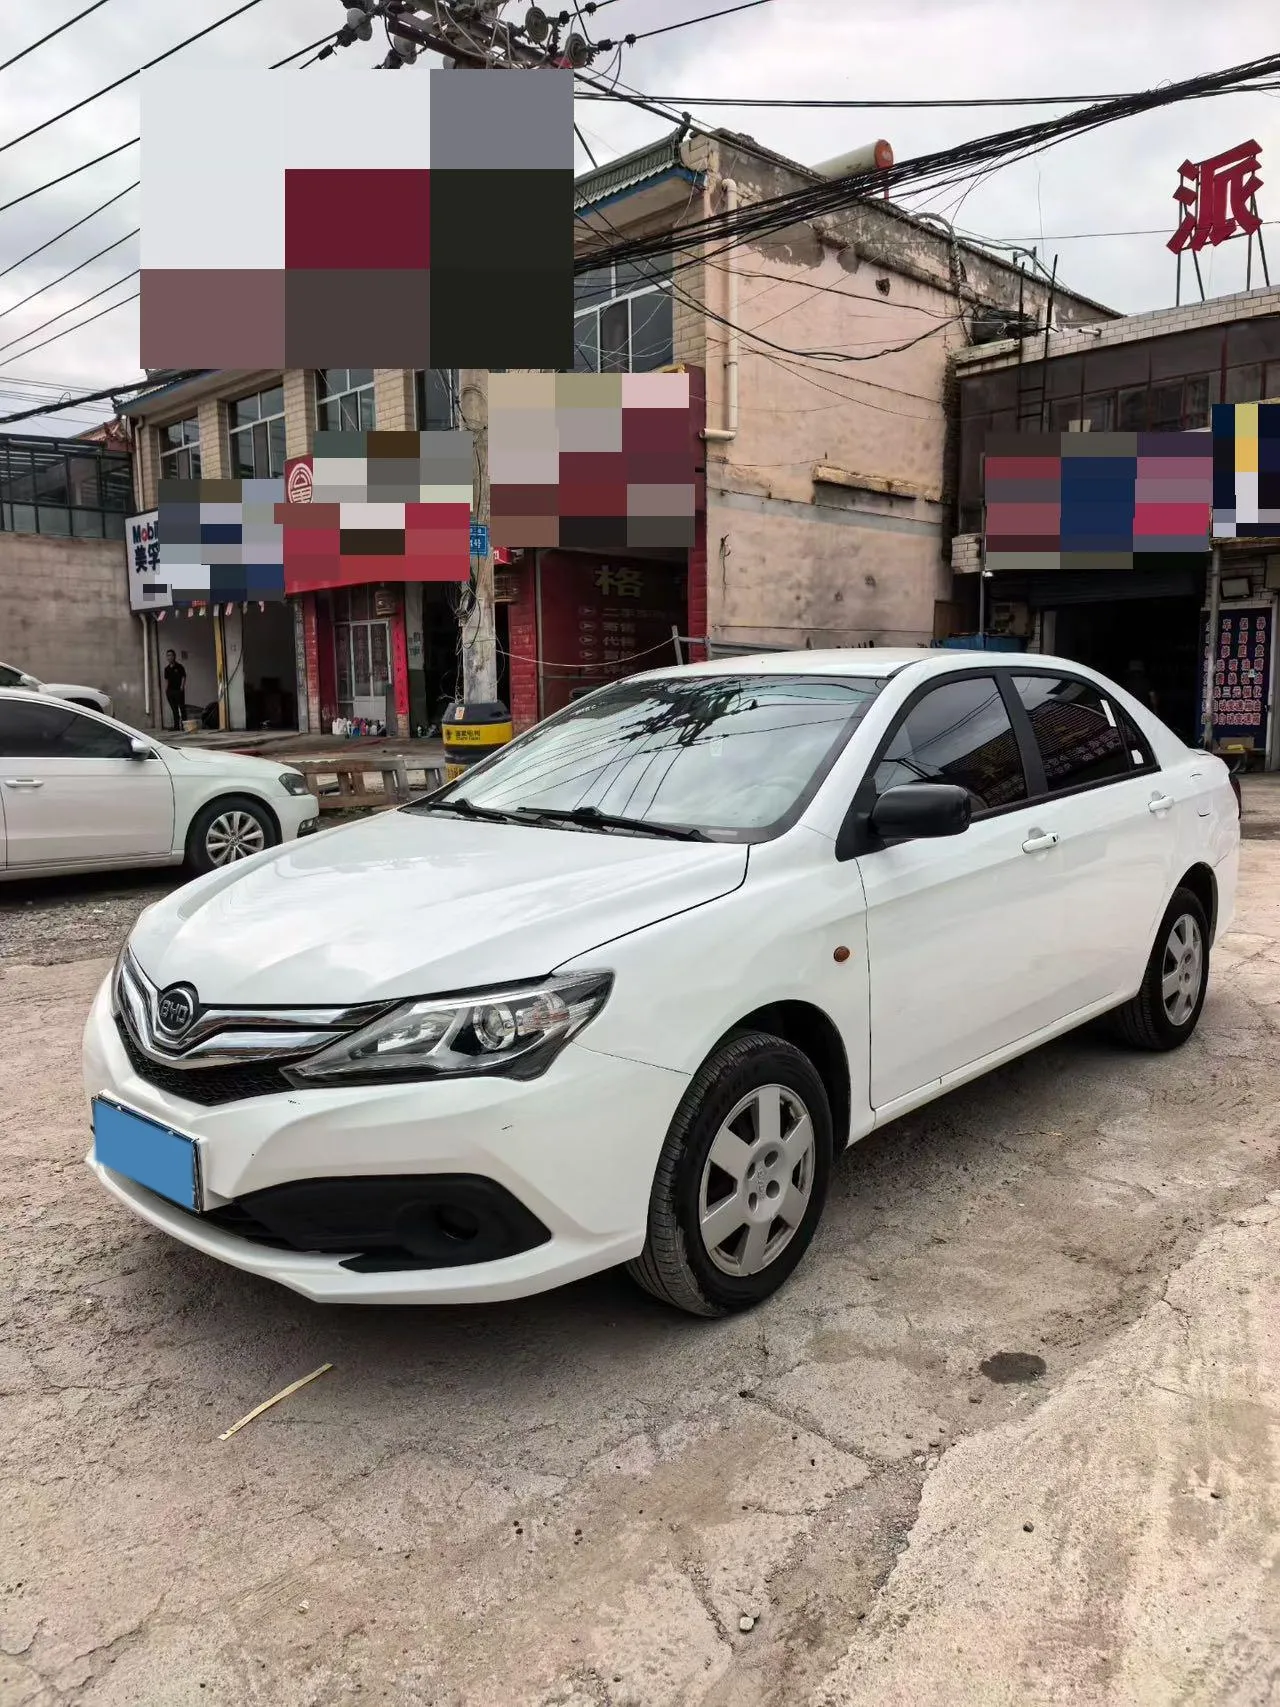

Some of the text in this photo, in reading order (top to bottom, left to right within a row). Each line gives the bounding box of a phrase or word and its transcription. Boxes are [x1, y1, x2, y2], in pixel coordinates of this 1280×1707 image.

[1166, 138, 1264, 255] 派
[134, 541, 161, 574] 美孚
[594, 564, 644, 598] 格
[160, 999, 189, 1024] BYD
